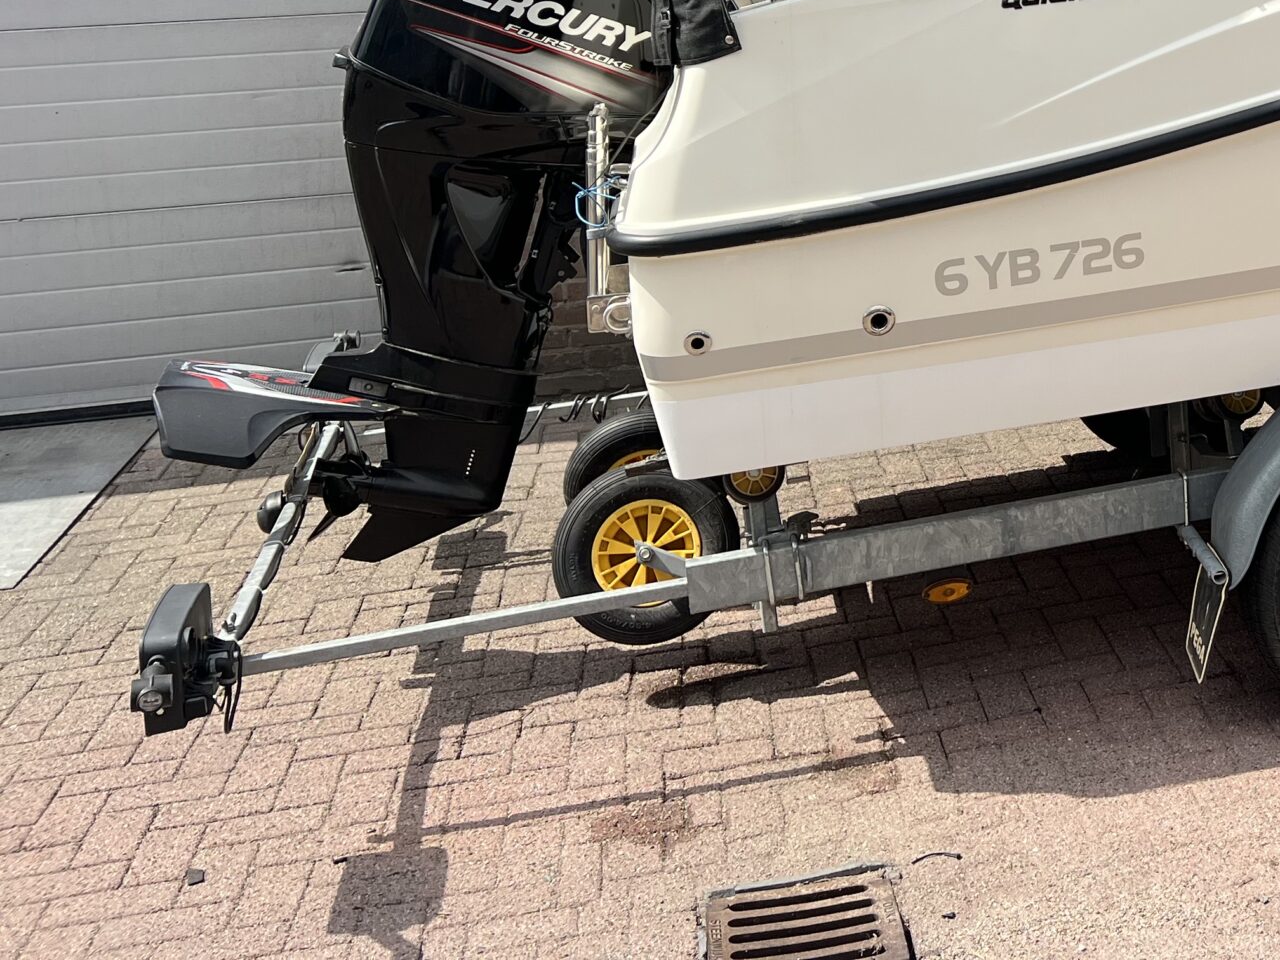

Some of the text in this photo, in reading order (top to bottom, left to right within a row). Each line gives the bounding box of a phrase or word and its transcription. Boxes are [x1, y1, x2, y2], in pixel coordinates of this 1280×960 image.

[503, 22, 634, 71] FOURSTROKE
[1049, 231, 1145, 281] 726
[1190, 621, 1206, 665] PEGA
